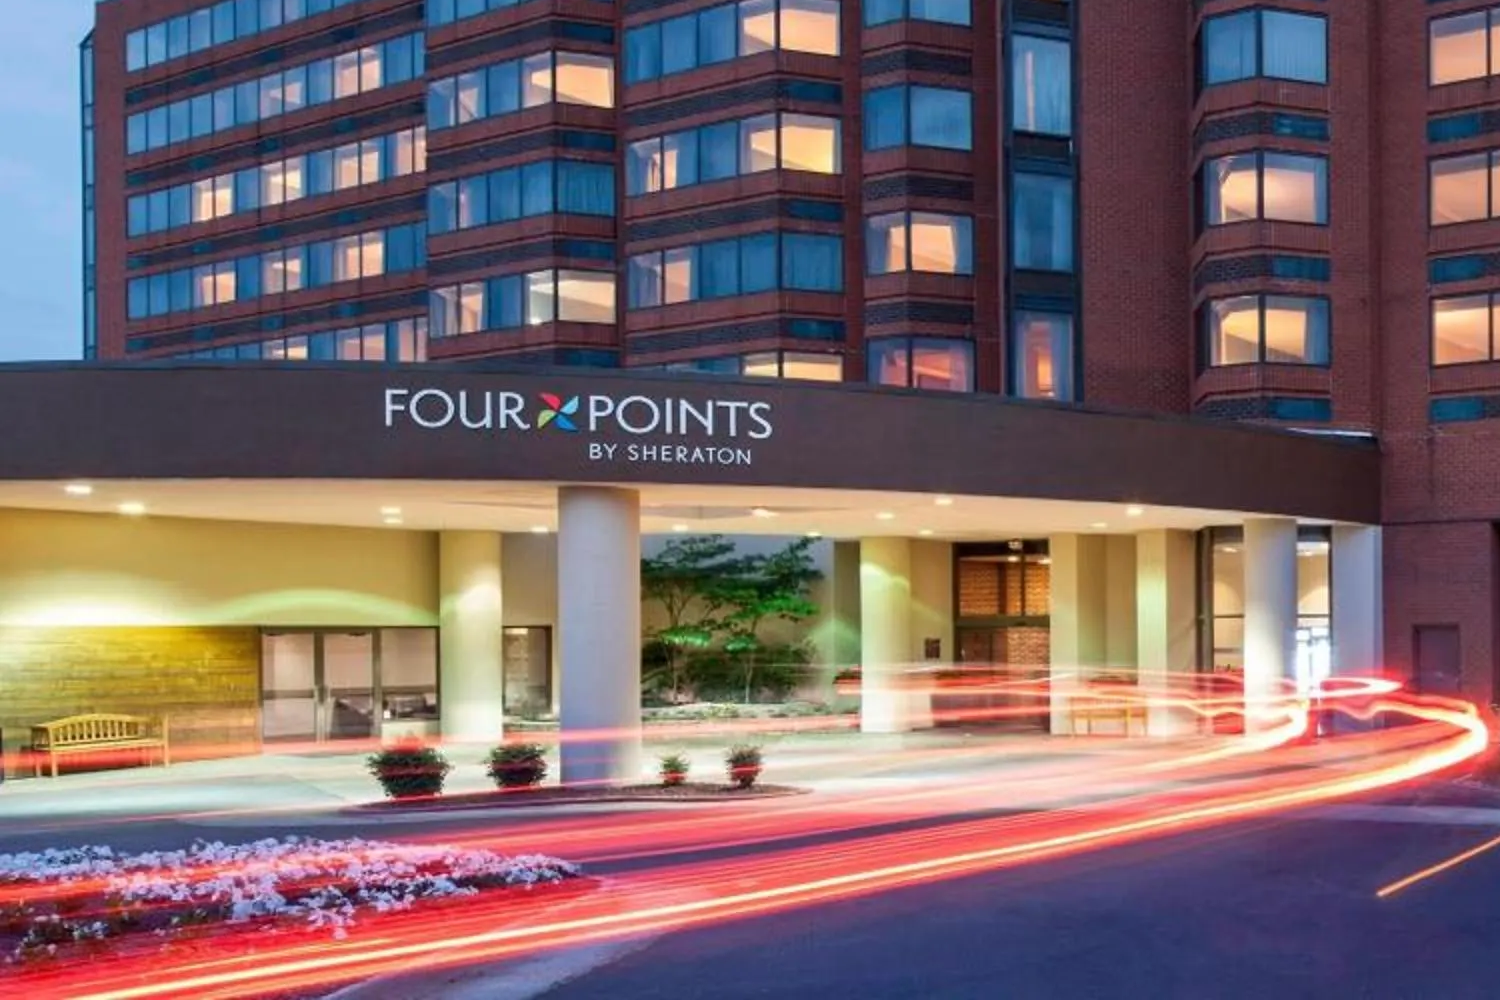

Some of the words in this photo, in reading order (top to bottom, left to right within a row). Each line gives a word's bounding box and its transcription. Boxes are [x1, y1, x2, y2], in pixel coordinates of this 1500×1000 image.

[385, 388, 530, 430] FOUR
[588, 395, 773, 439] POINTS
[588, 443, 617, 460] BY
[627, 445, 752, 465] SHERATON
